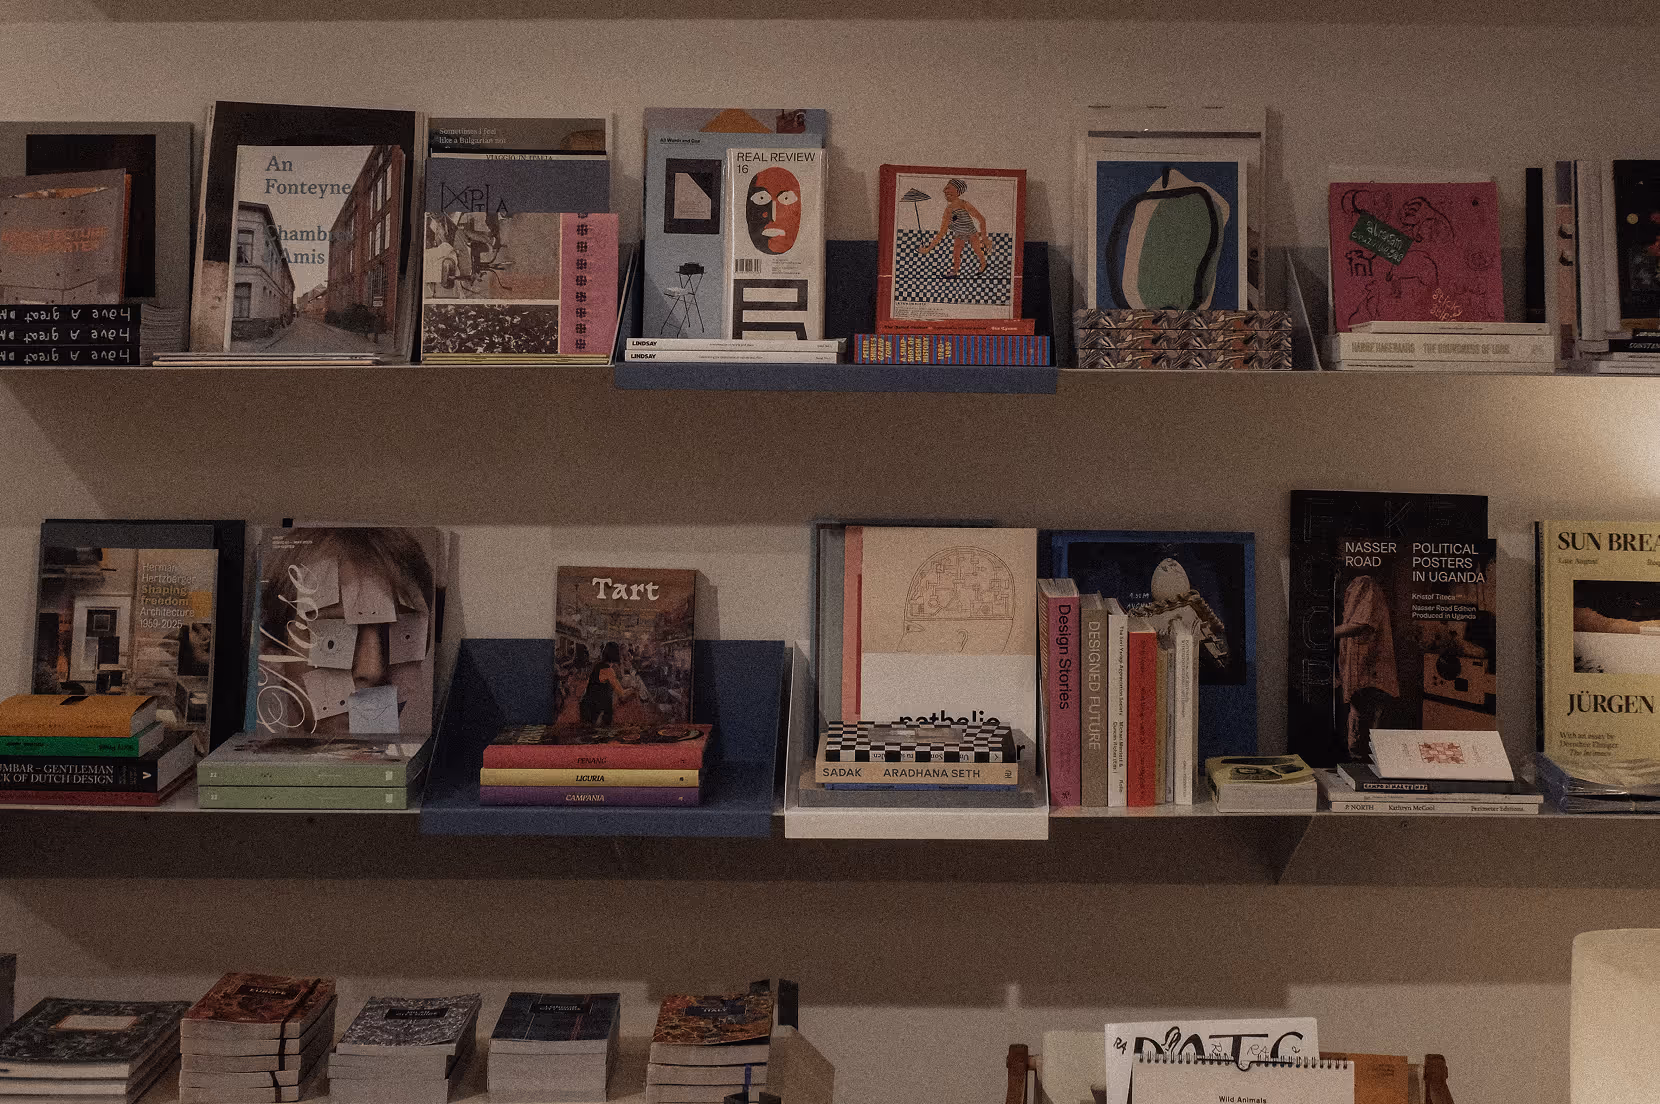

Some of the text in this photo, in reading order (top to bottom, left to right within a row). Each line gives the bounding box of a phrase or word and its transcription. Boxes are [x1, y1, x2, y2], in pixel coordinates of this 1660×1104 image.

[737, 153, 815, 162] REAL REVIEW
[265, 155, 293, 172] An
[737, 165, 749, 174] 16
[264, 178, 353, 199] Fonteyne
[24, 306, 60, 323] great
[71, 309, 81, 320] A
[23, 327, 59, 344] great
[70, 329, 80, 340] A
[908, 337, 914, 345] OF
[862, 340, 870, 359] PETER
[922, 336, 930, 363] HISTORY
[23, 347, 59, 365] great
[70, 350, 80, 361] A
[1558, 532, 1602, 551] SUN
[1345, 542, 1397, 553] NASSER
[1412, 543, 1479, 555] POLITICAL
[1345, 556, 1381, 567] ROAD
[1412, 557, 1473, 568] POSTERS
[142, 563, 178, 572] Herman
[142, 574, 196, 585] Hertzberger
[1412, 571, 1486, 583] IN UGANDA
[142, 585, 187, 596] Shaping
[592, 577, 660, 601] Tart
[141, 596, 189, 606] freedom
[140, 607, 195, 617] Architecture
[1412, 604, 1435, 612] Nasser
[1436, 604, 1452, 612] Road
[1452, 612, 1477, 620] Uganda
[140, 618, 183, 629] 1959-2025
[1058, 604, 1072, 710] Design Stories
[1087, 621, 1101, 750] DESIGNED FUTURE
[1567, 690, 1655, 717] JÜRGEN
[0, 764, 34, 774] MBAR
[44, 765, 114, 775] GENTLEMAN
[822, 769, 980, 779] SADAK ARADHANA SETH
[14, 774, 28, 784] OF
[30, 774, 70, 784] DUTCH
[73, 775, 114, 785] DESIGN
[565, 794, 605, 802] CAMPANIA
[1237, 1096, 1266, 1104] Animals
